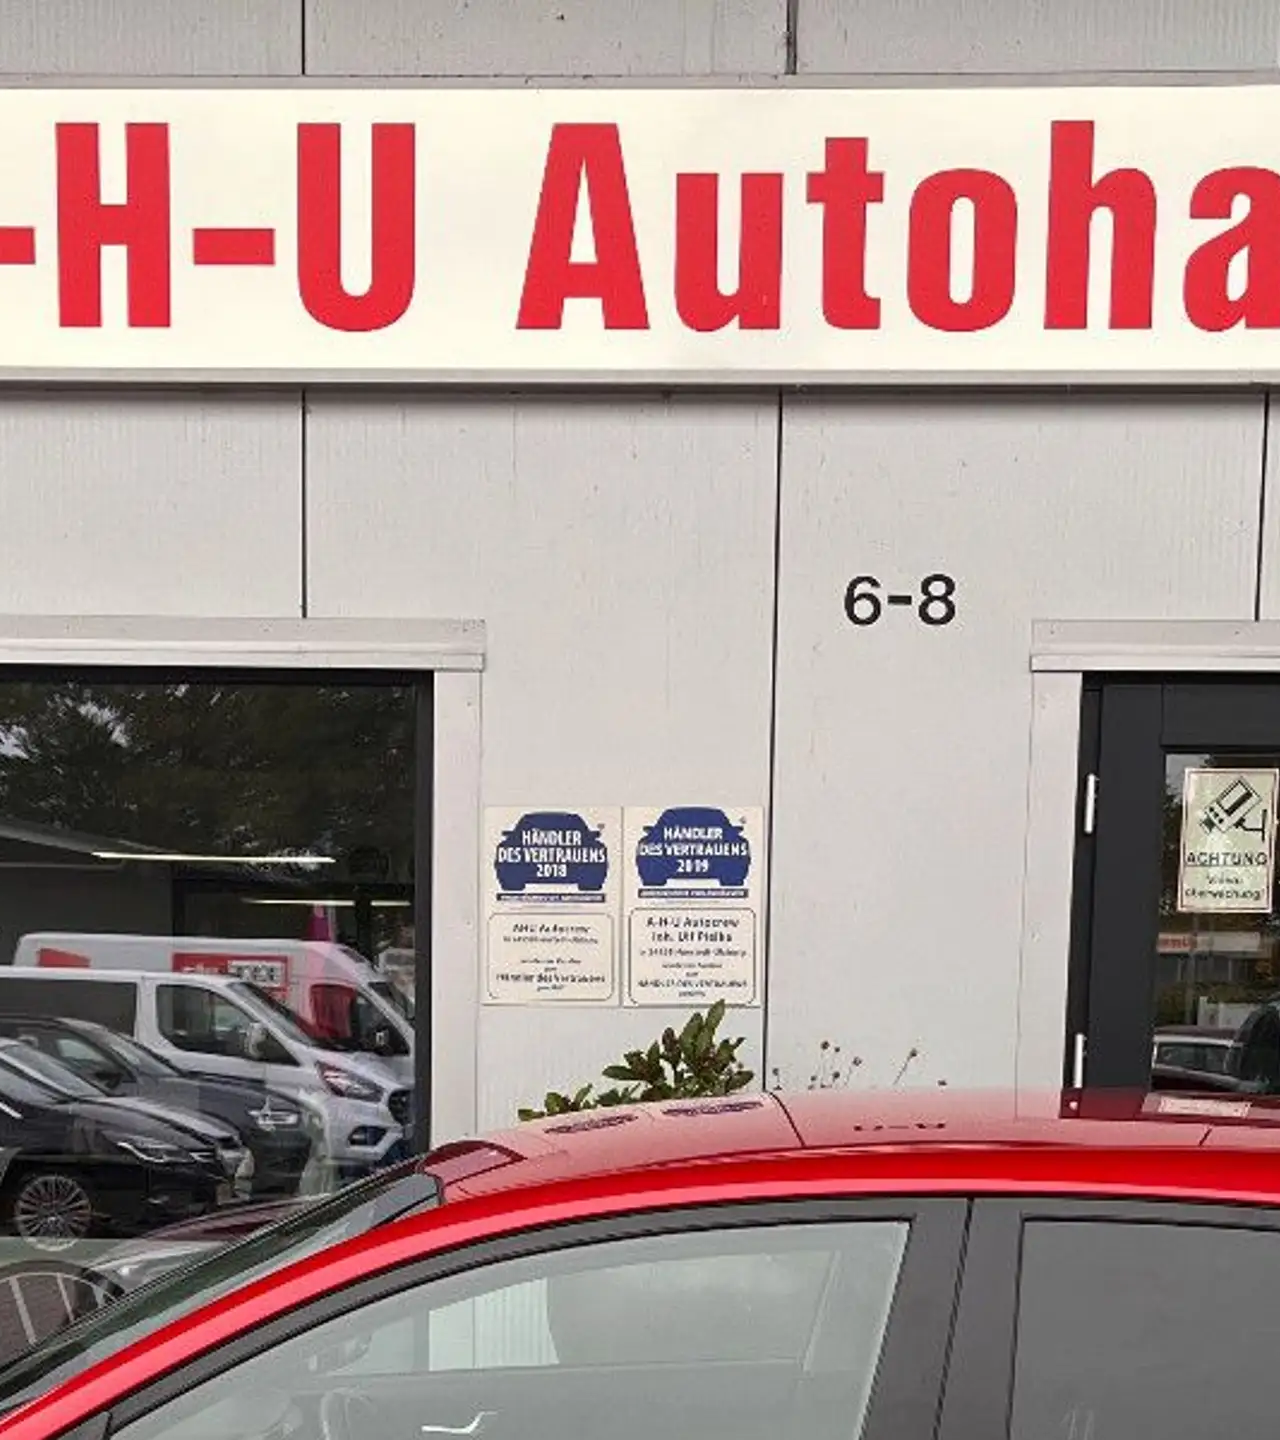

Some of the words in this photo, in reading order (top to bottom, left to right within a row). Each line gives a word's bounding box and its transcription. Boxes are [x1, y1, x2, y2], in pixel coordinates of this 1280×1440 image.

[844, 573, 956, 626] 6-8
[522, 828, 582, 846] HÄNDLER
[663, 825, 723, 840] HÄNDLER
[498, 847, 522, 863] DES
[1187, 852, 1268, 866] ACHTUNG
